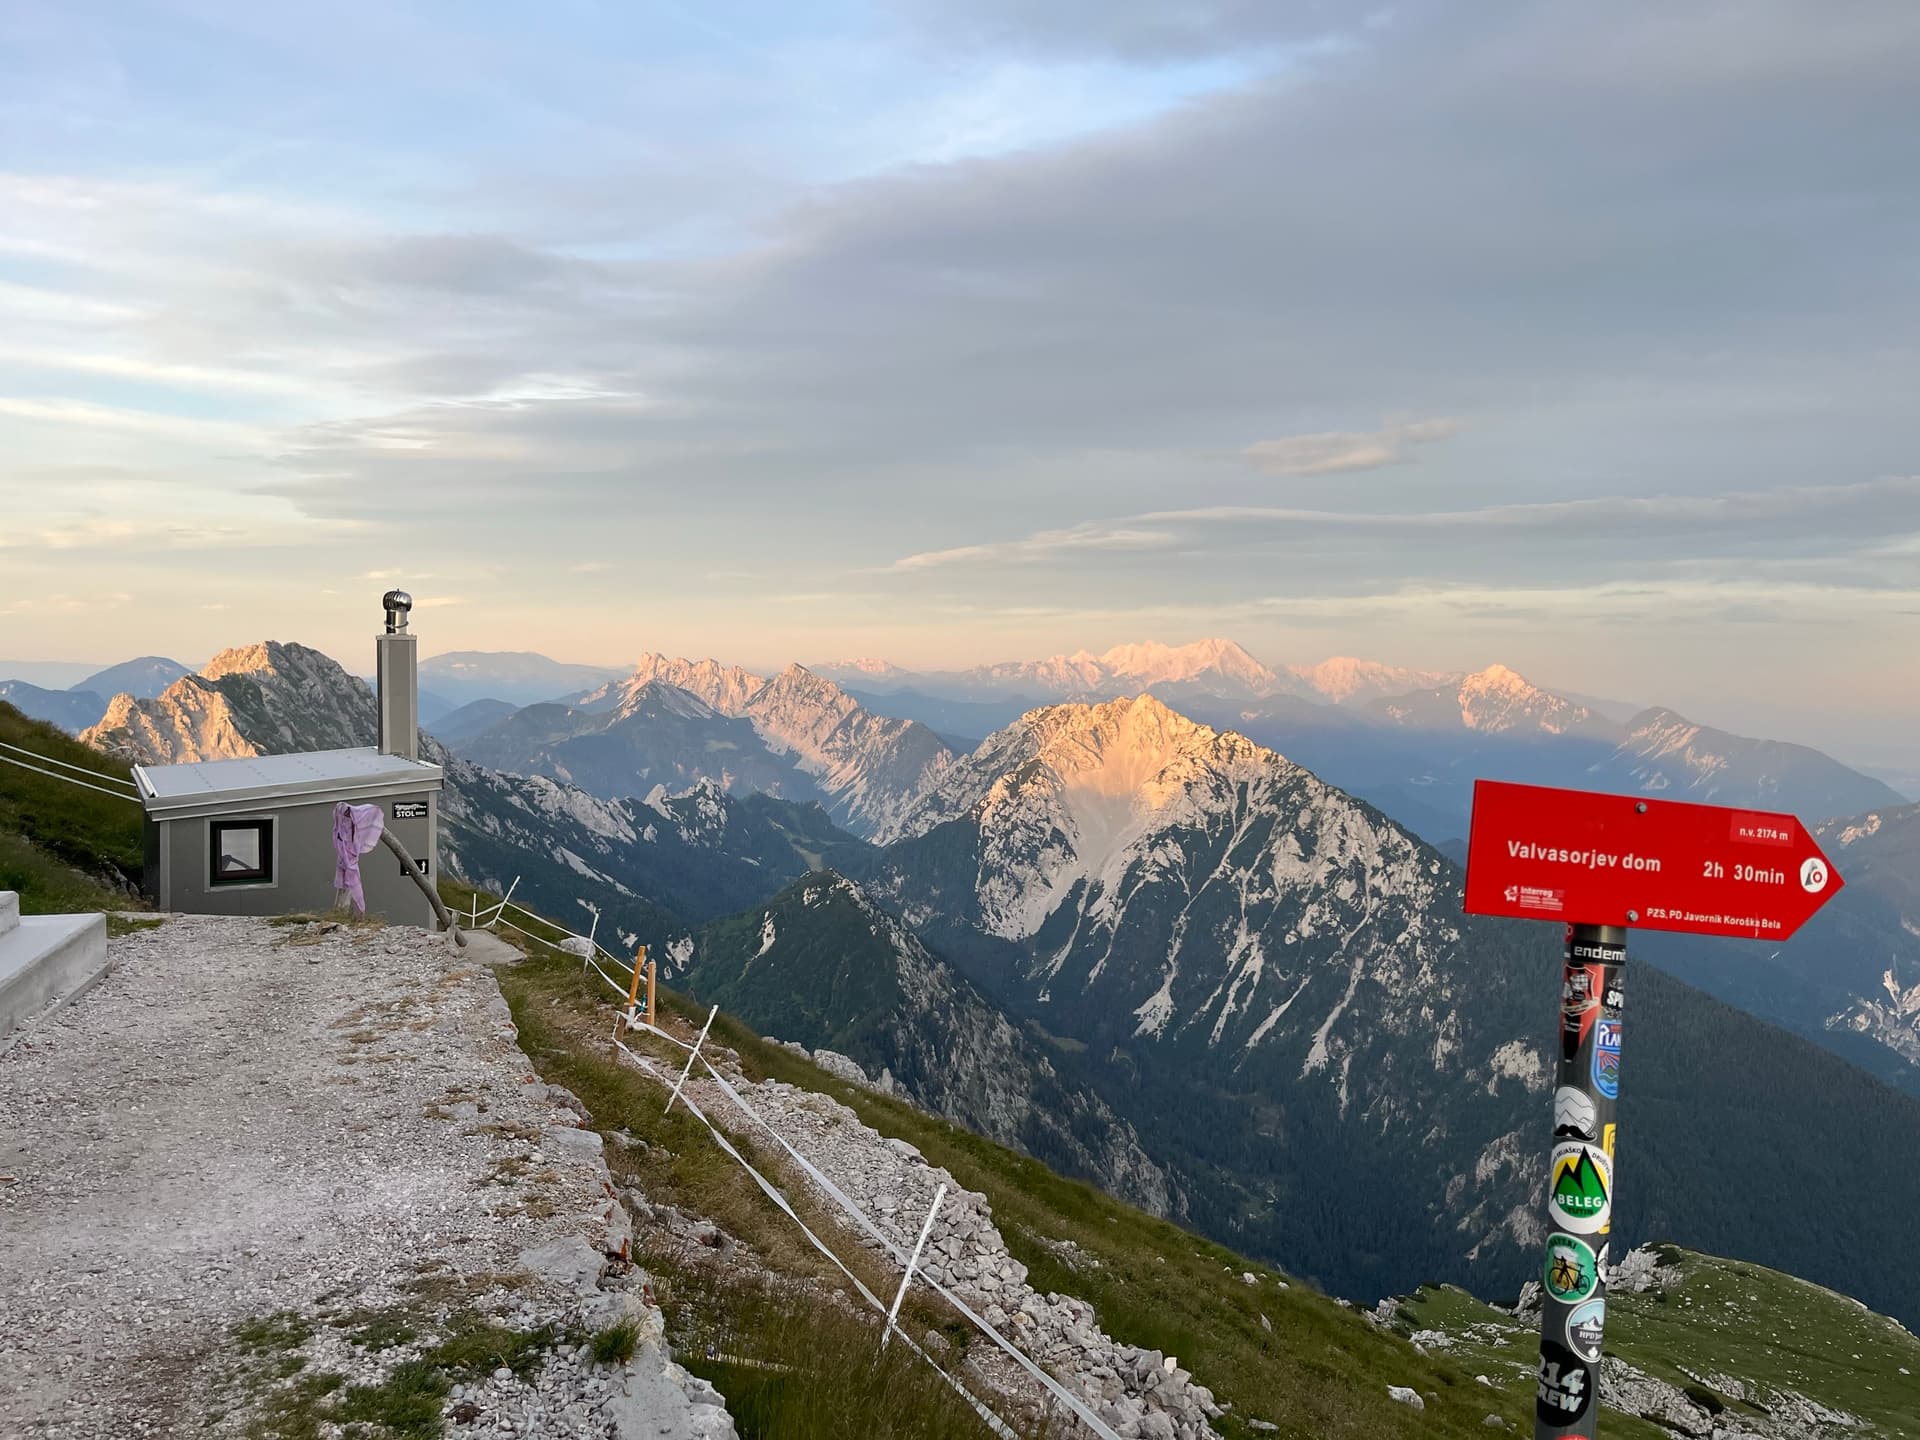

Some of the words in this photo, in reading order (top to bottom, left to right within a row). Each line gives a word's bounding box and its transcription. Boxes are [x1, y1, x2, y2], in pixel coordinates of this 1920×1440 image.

[396, 810, 416, 818] STOL
[1756, 828, 1778, 840] 2174
[1778, 831, 1789, 841] m
[1507, 840, 1618, 869] Valvasorjev
[1622, 853, 1662, 872] dom
[1703, 860, 1725, 878] 2h
[1733, 864, 1785, 885] 30min
[1669, 909, 1683, 920] PD
[1683, 912, 1722, 924] Javornik
[1723, 914, 1760, 928] Koroška
[1761, 918, 1782, 930] Bela
[1557, 1193, 1603, 1208] BELEG
[1567, 1206, 1594, 1216] TUTIN
[1537, 1380, 1583, 1413] REW
